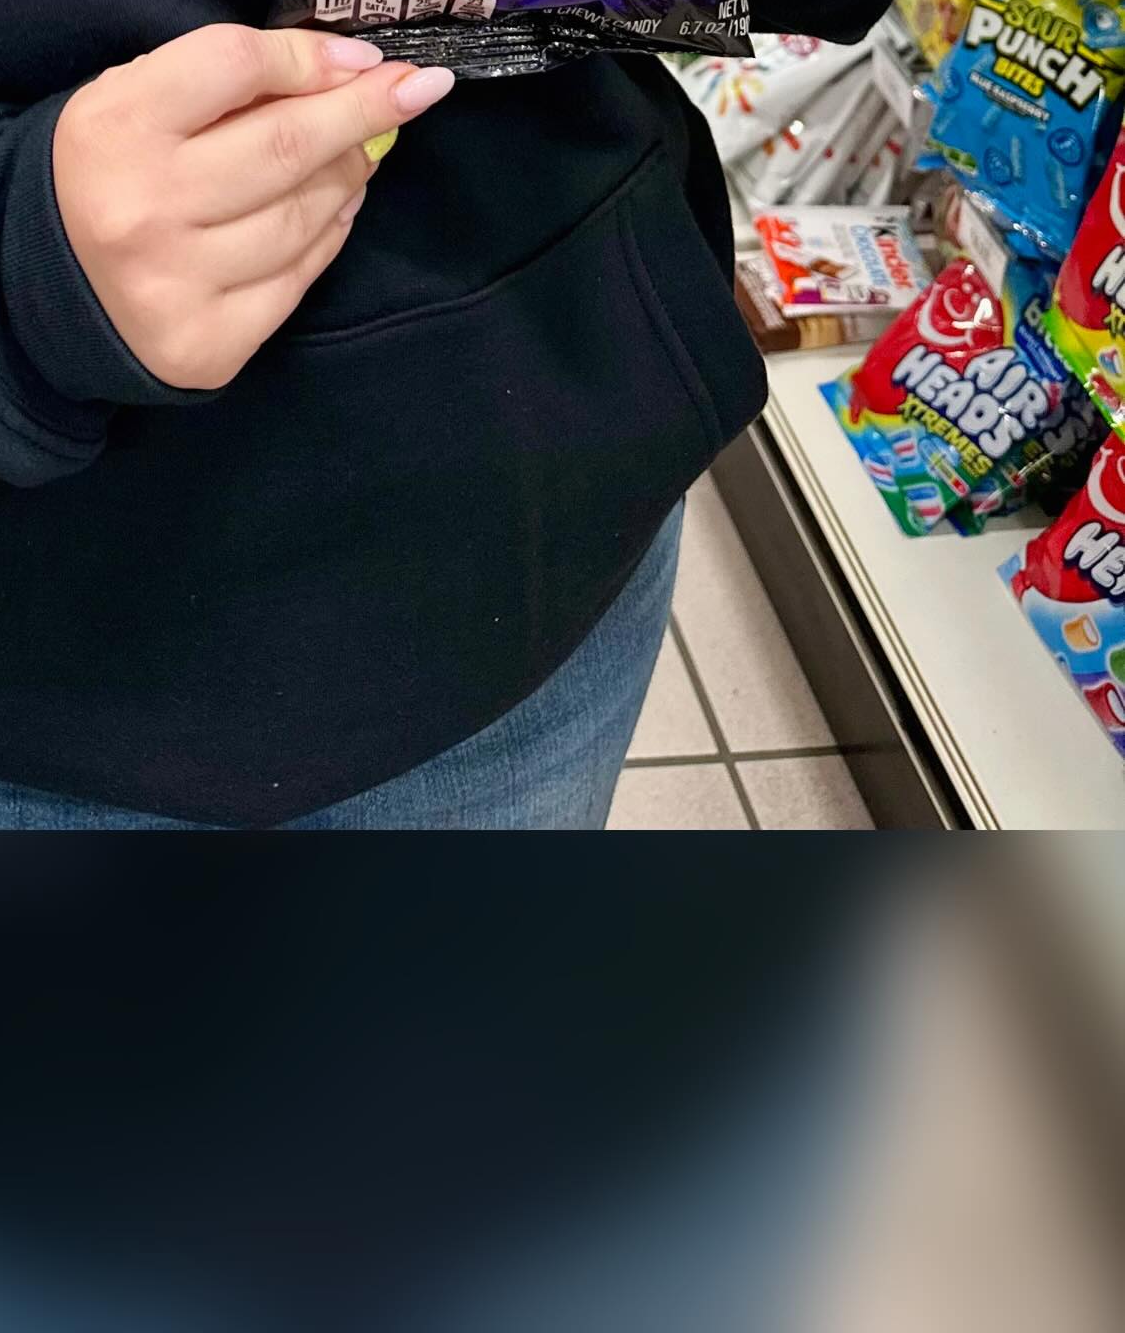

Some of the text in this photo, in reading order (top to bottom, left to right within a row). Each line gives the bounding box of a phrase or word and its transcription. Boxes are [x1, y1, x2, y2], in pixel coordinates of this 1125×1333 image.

[365, 2, 396, 14] SAT FAT
[679, 21, 703, 35] 6.7
[965, 4, 1104, 108] PUNCH
[892, 344, 1025, 459] HEADS
[963, 348, 1050, 429] AIR
[898, 392, 995, 478] XTREMES
